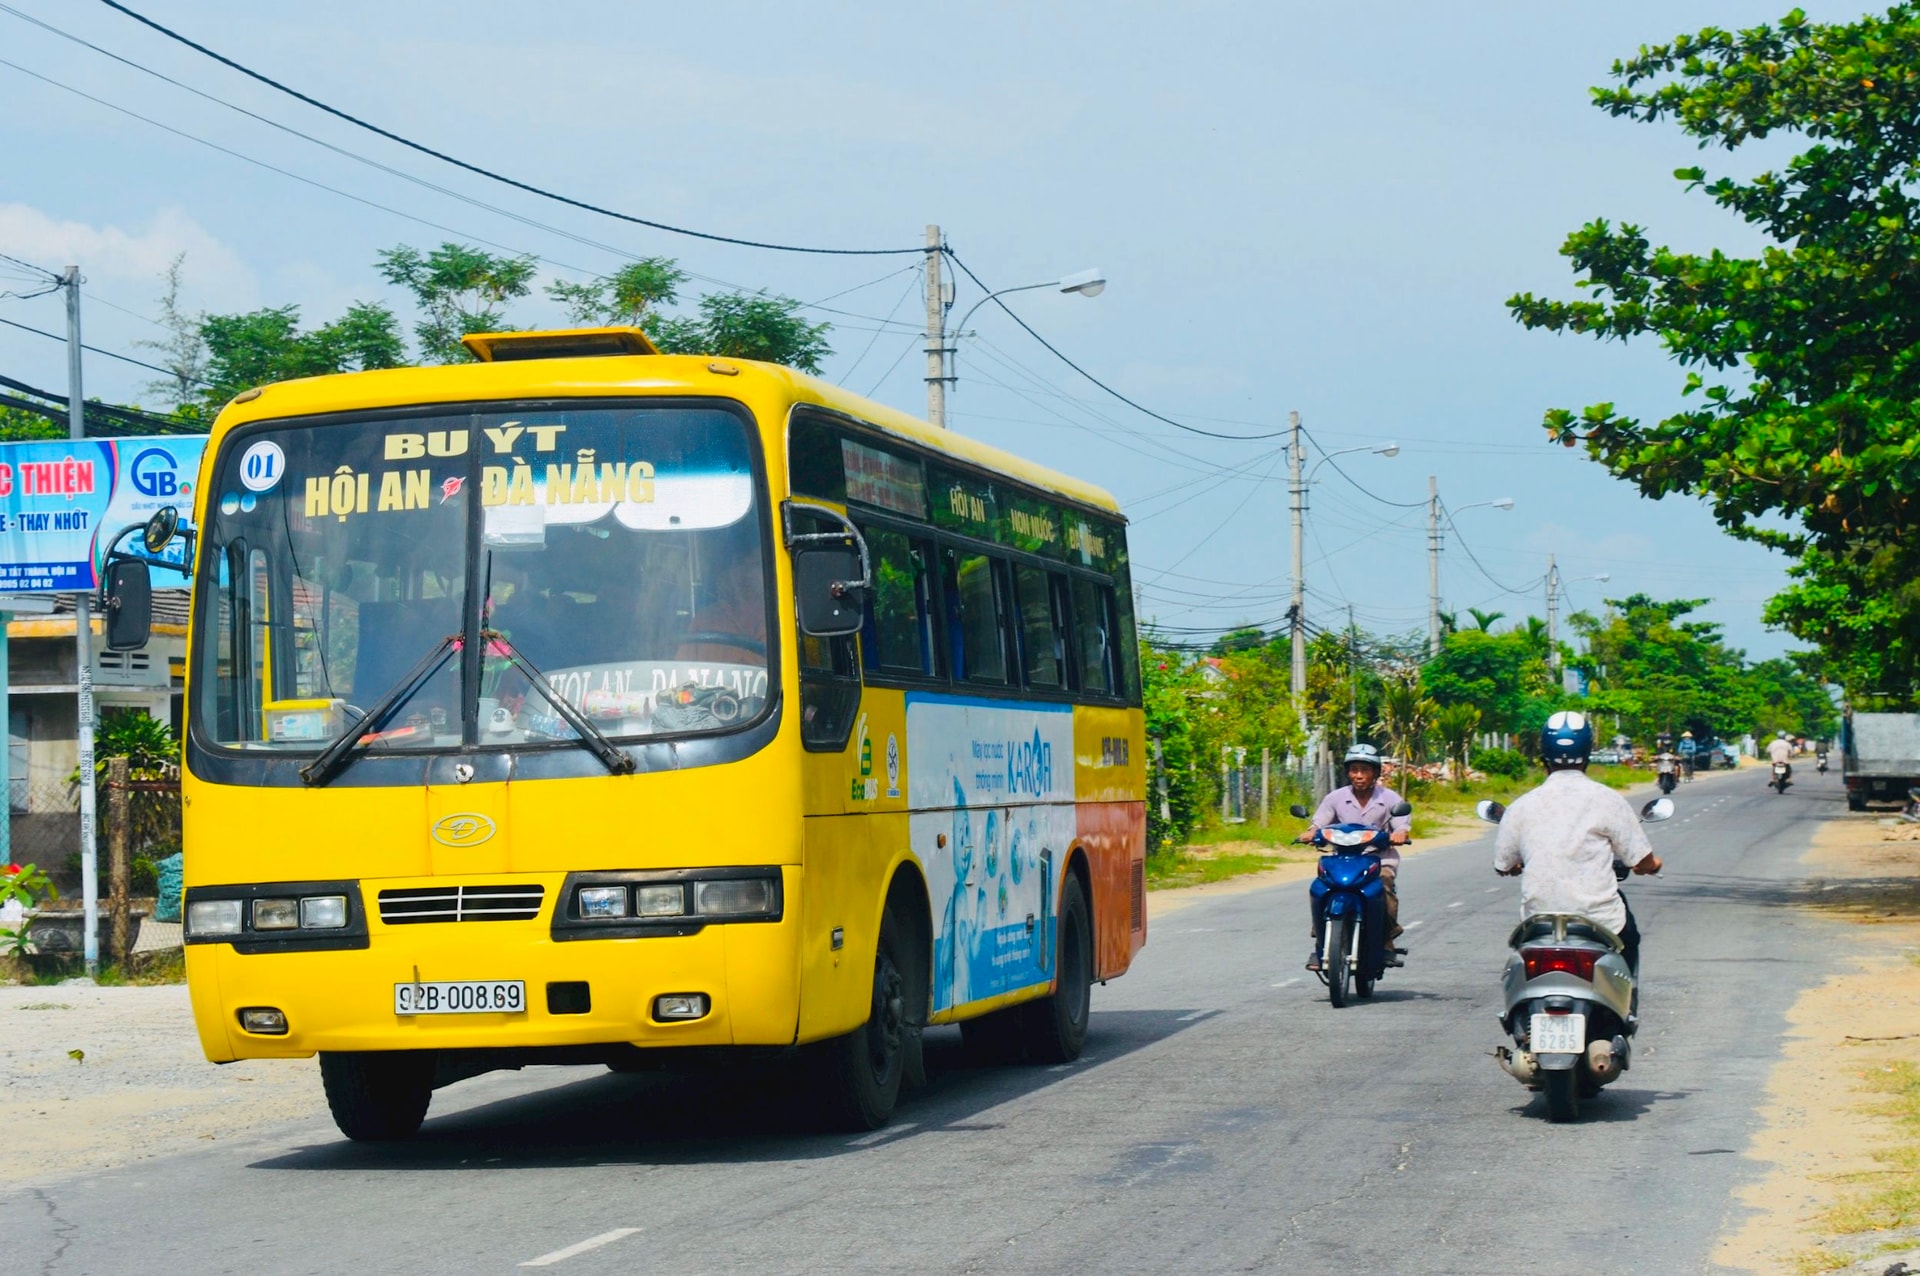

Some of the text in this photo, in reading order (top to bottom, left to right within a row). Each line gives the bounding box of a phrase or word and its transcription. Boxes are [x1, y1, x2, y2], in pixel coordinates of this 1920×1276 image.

[384, 421, 567, 460] BU ÝT
[20, 457, 94, 499] THIỆN
[247, 452, 275, 479] 01
[305, 448, 656, 523] HỘI AN ĐÀ NẴNG
[18, 513, 50, 532] THAY
[971, 497, 986, 523] AN
[399, 985, 520, 1011] 92B-008.69
